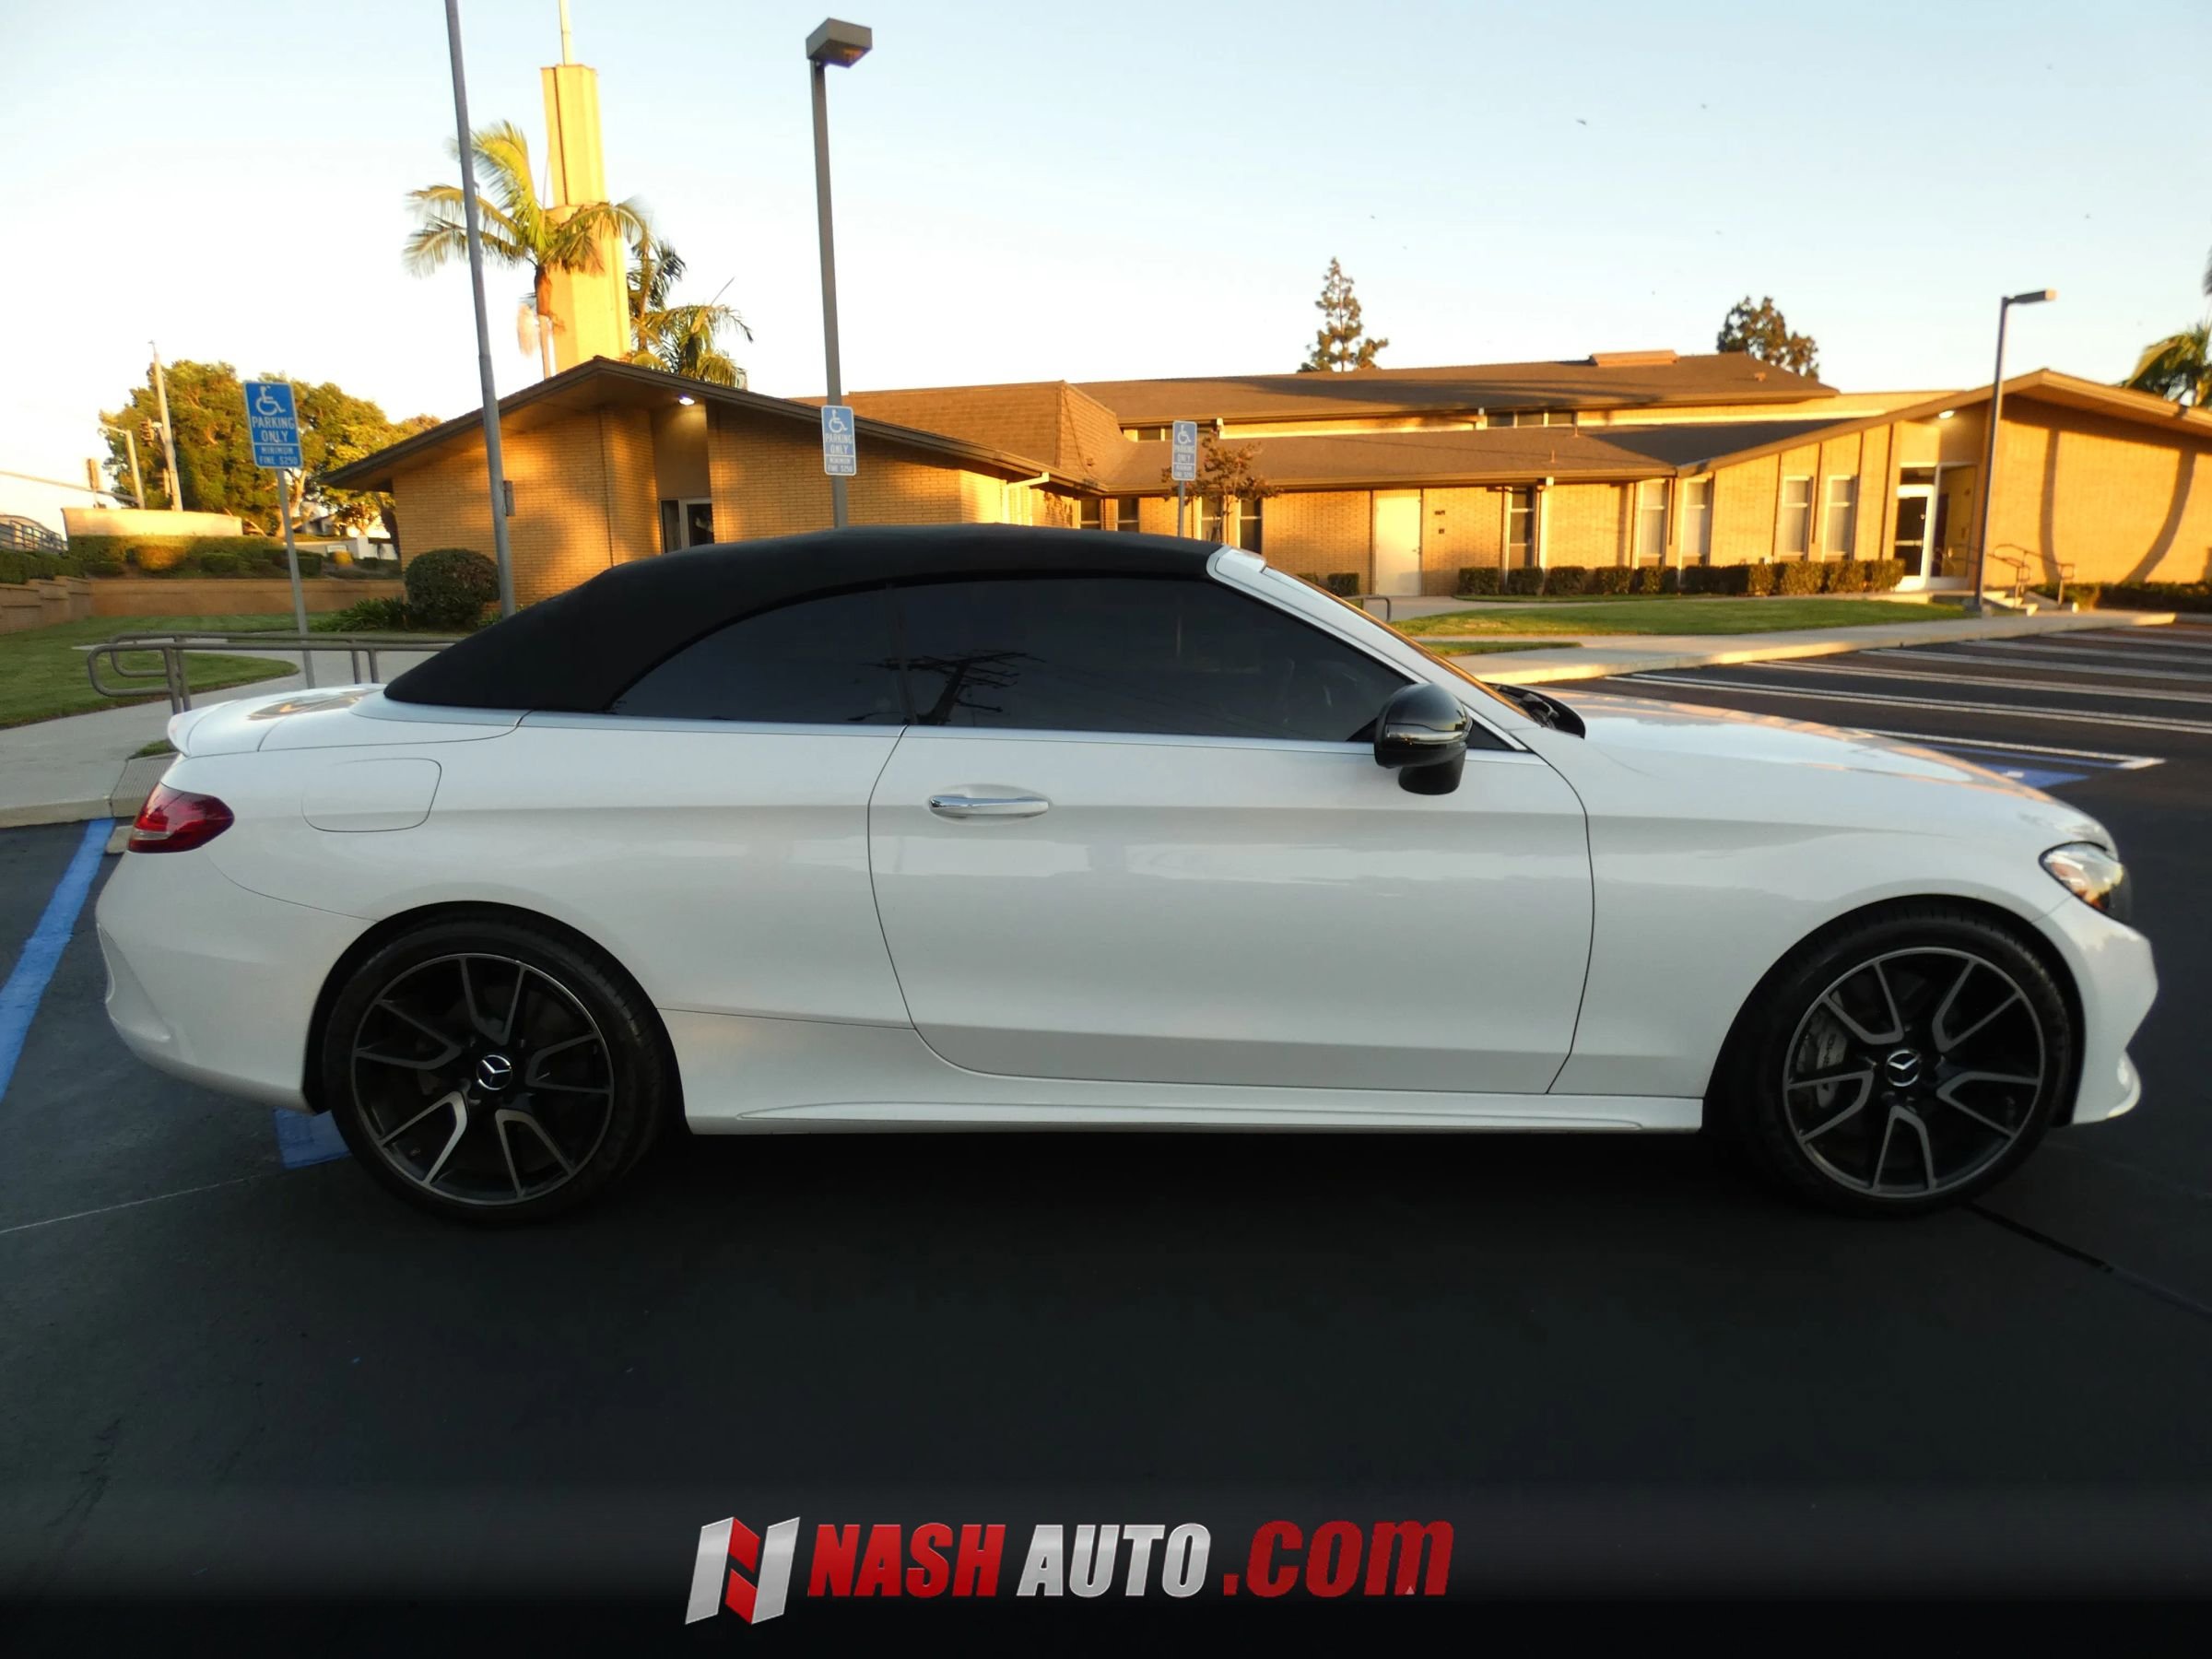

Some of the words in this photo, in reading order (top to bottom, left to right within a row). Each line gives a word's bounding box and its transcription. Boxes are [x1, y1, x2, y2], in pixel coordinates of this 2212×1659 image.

[252, 417, 296, 429] PARKING
[261, 429, 288, 442] ONLY
[825, 433, 853, 444] PARKING
[830, 444, 849, 454] ONLY
